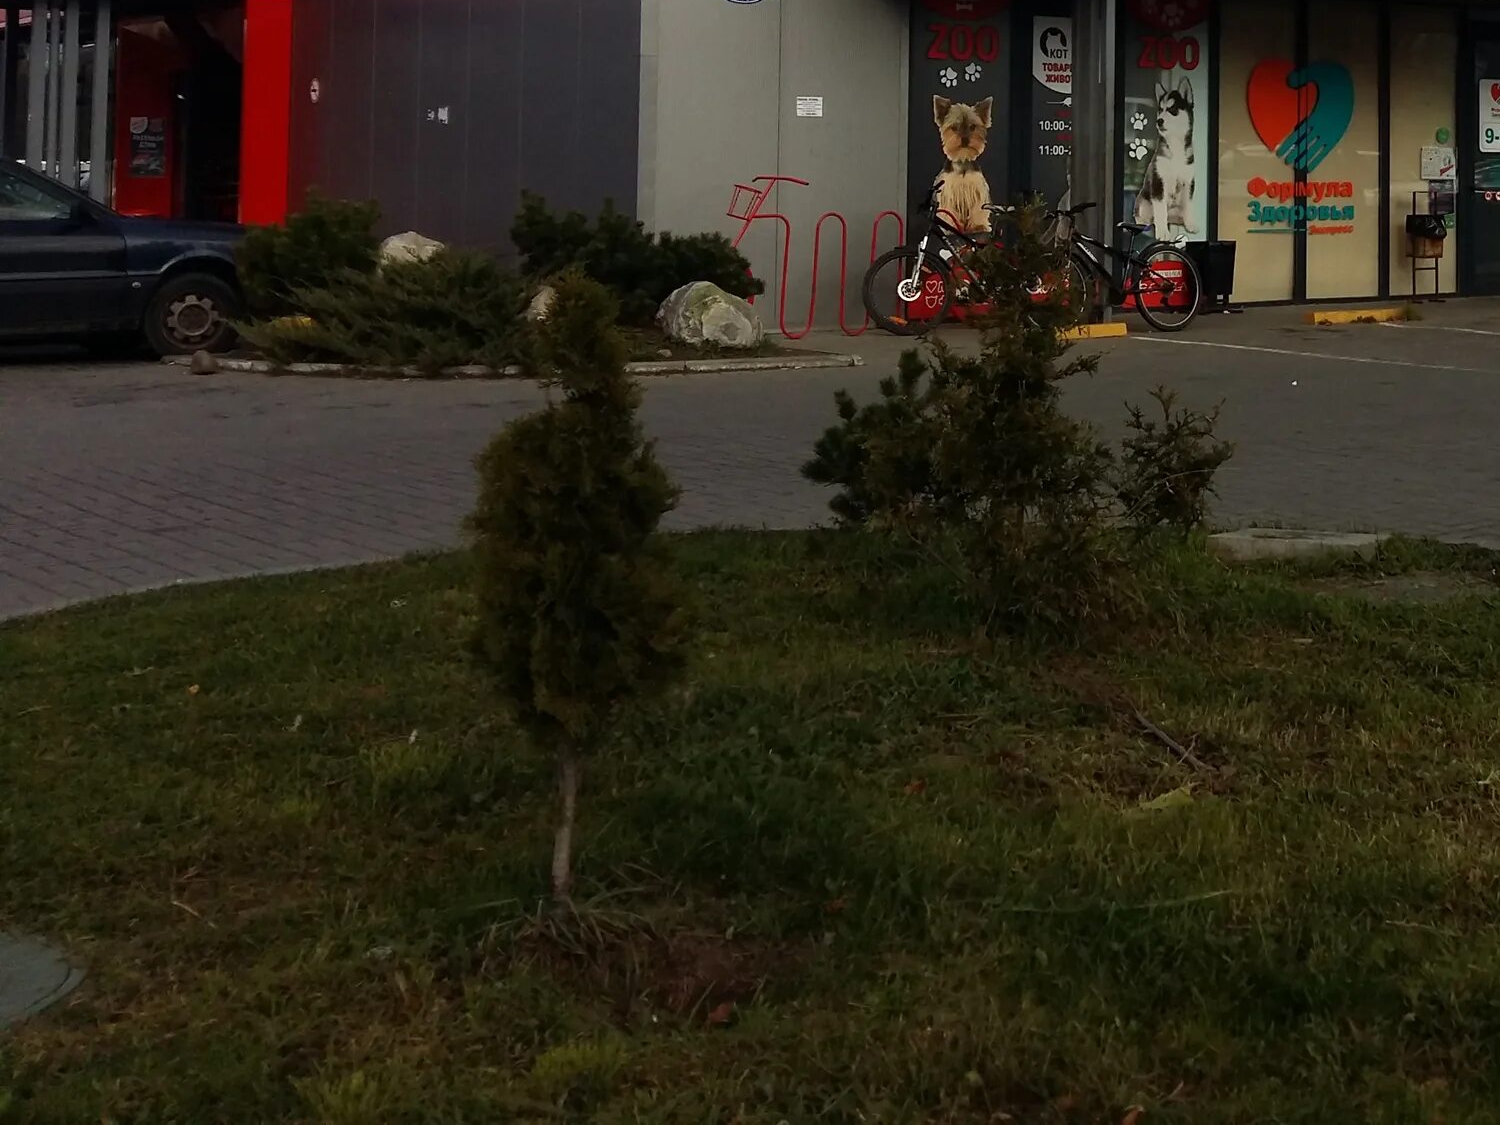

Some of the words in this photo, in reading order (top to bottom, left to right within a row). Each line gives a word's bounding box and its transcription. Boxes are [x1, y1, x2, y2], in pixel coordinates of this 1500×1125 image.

[927, 23, 1000, 63] ZOO
[1050, 48, 1068, 59] КОТ
[1136, 35, 1201, 71] ZOO
[1247, 177, 1353, 203] Формула
[1247, 200, 1355, 226] Здоровья
